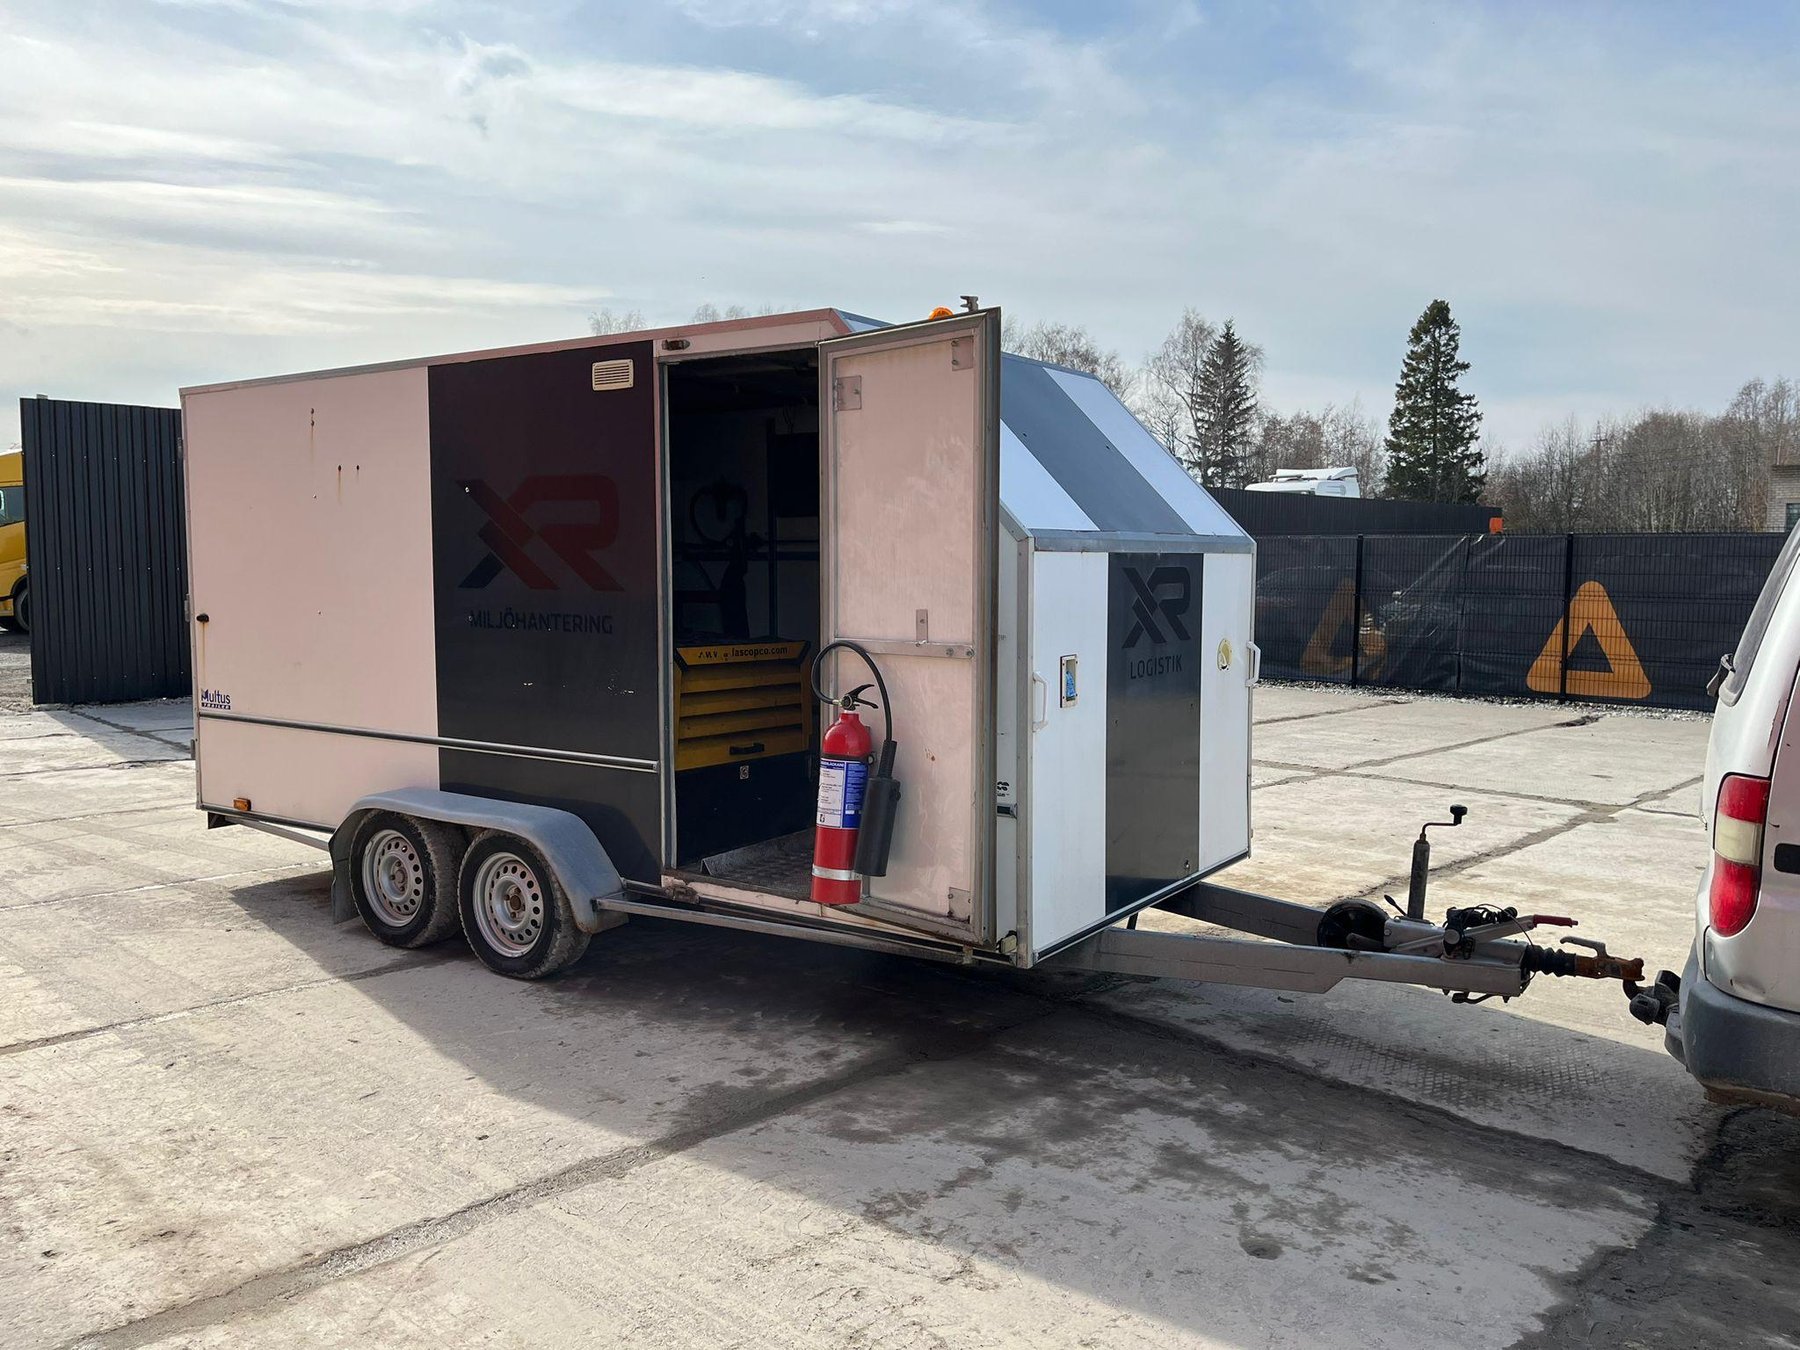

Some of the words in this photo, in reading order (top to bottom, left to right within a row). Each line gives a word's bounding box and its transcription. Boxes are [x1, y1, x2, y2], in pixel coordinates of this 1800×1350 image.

[456, 475, 626, 592] XR
[469, 607, 613, 634] MILJÖHANTERING
[1121, 566, 1191, 649] XR
[1130, 654, 1183, 680] LOGISTIK
[200, 689, 231, 704] Multus
